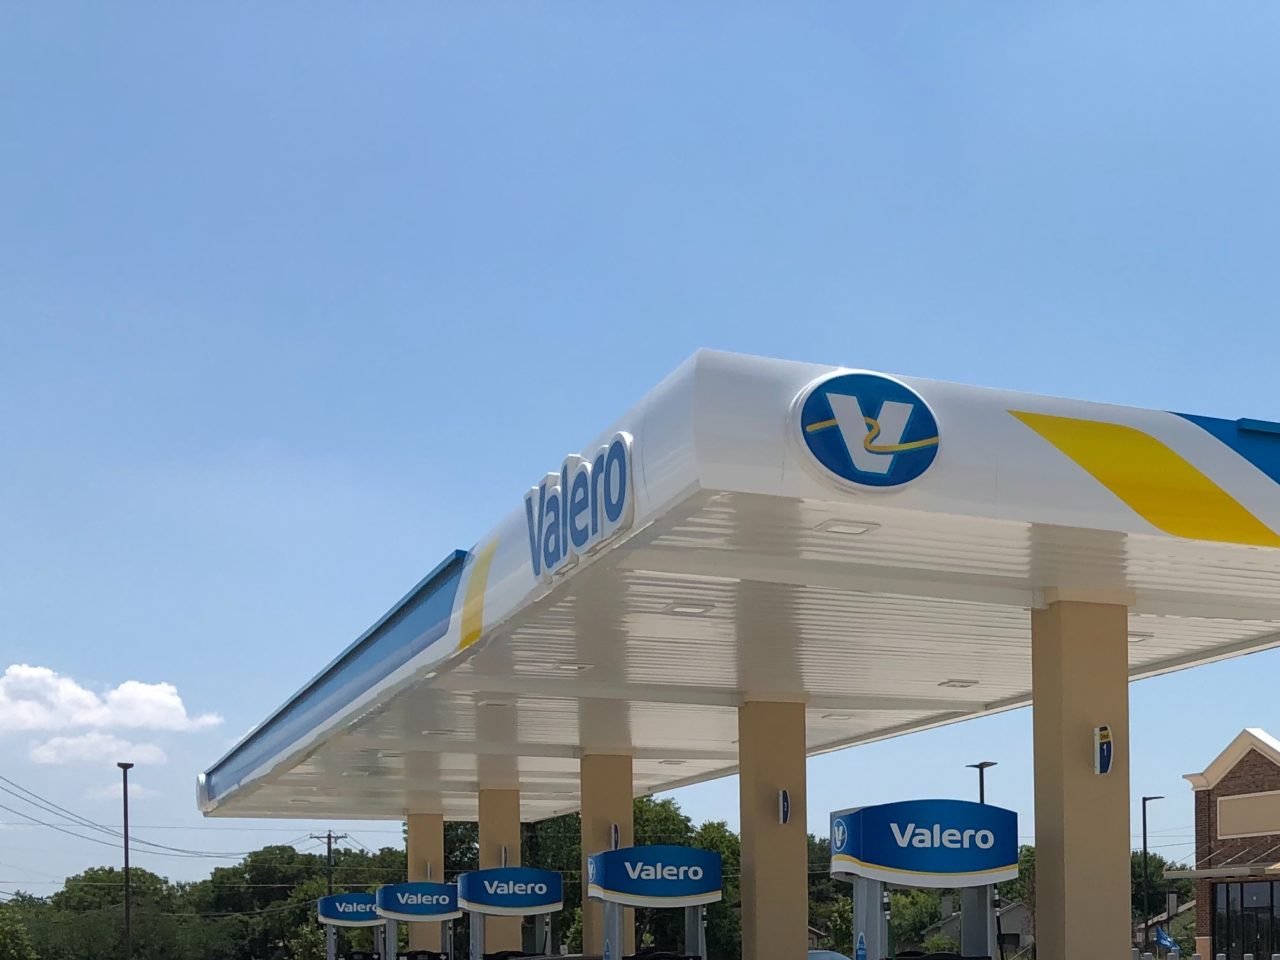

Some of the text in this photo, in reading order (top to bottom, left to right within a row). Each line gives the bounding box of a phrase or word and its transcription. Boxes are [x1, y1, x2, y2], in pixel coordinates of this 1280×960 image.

[524, 438, 631, 578] Valero
[890, 823, 995, 849] Valero
[624, 862, 704, 881] Valero
[483, 880, 547, 895] Valero
[396, 893, 450, 905] Valero
